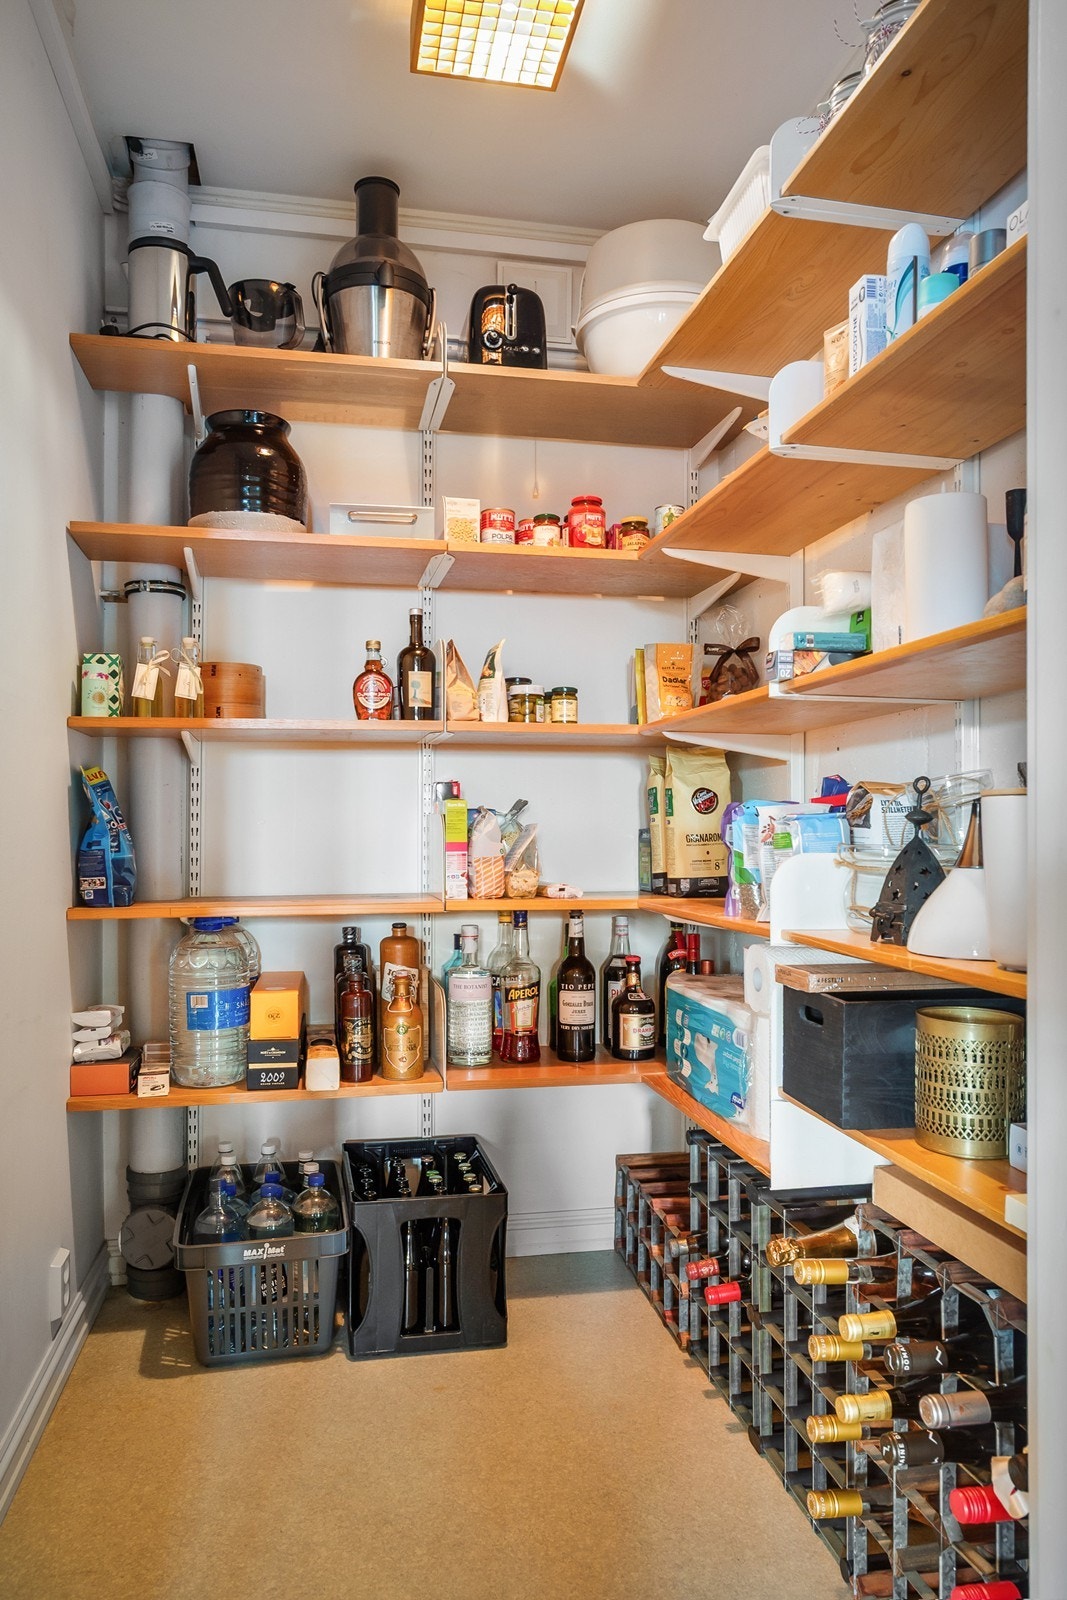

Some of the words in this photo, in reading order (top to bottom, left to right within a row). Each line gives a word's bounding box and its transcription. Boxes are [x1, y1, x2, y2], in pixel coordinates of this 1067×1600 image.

[662, 676, 687, 685] Dadlar
[714, 861, 720, 870] 8
[508, 986, 539, 1001] APEROL
[260, 1071, 285, 1083] 2009
